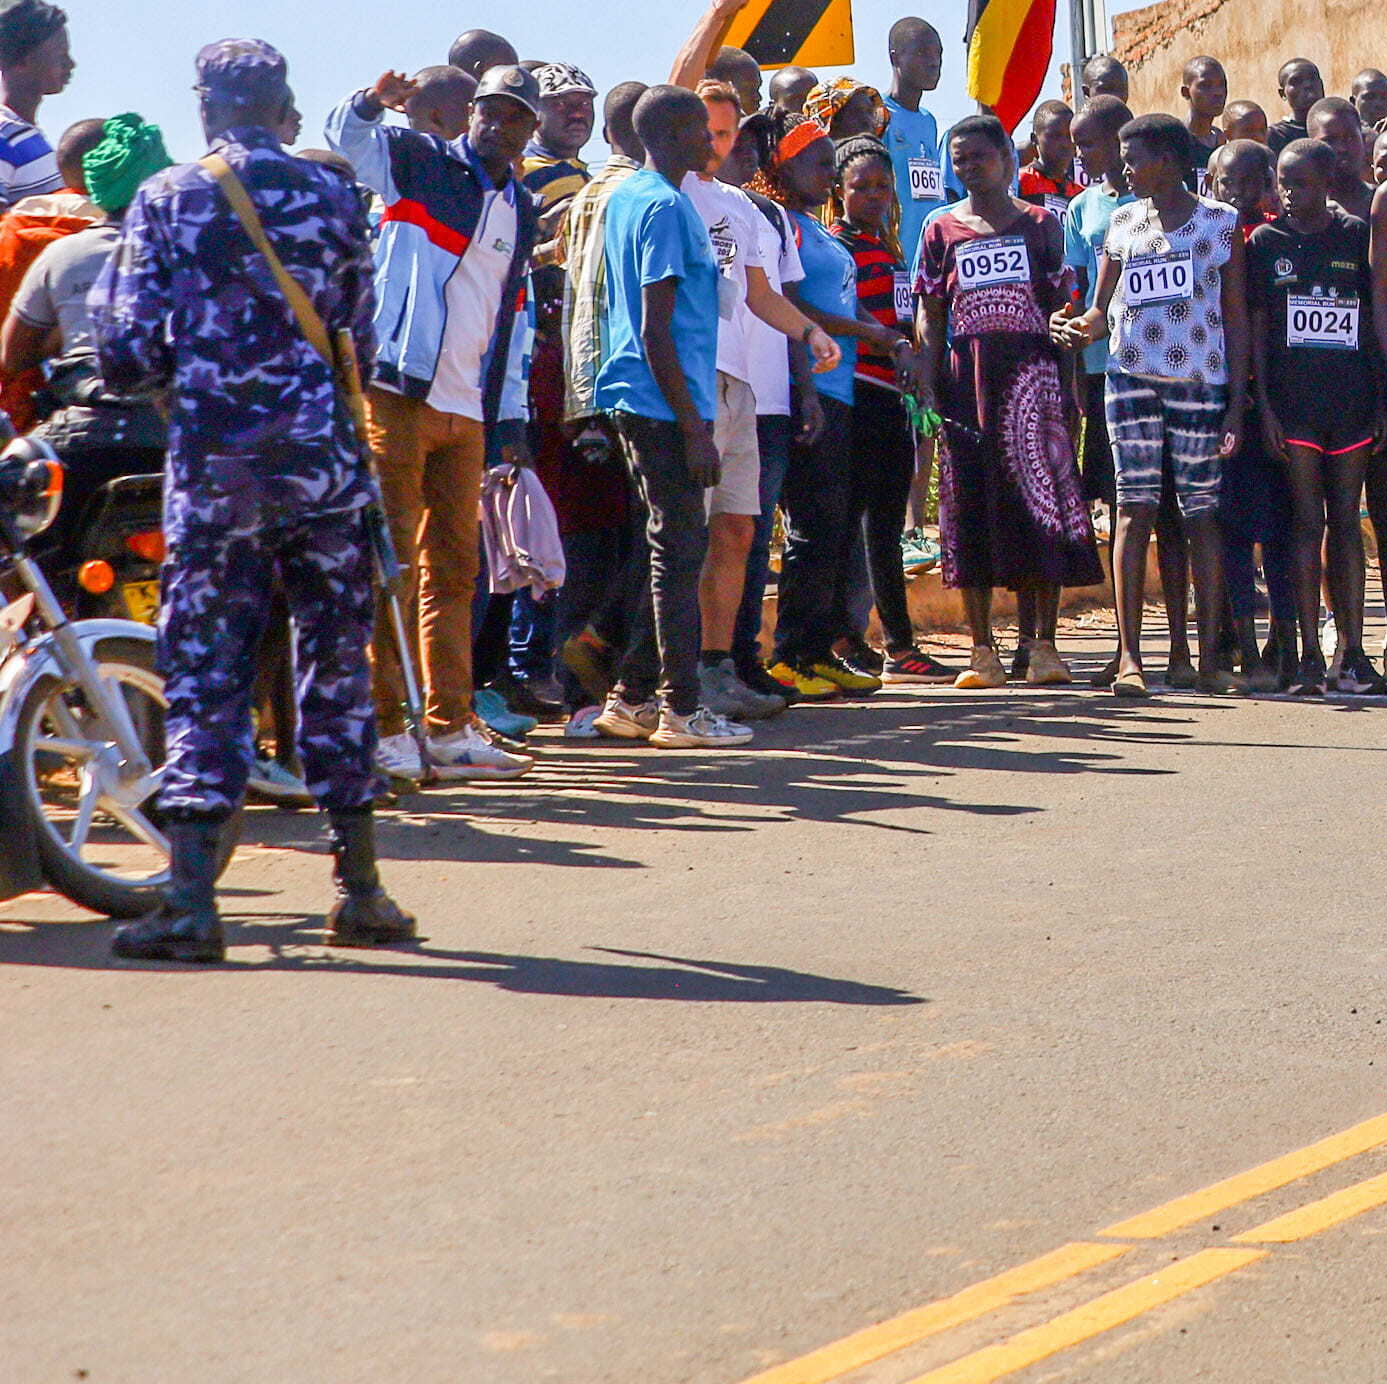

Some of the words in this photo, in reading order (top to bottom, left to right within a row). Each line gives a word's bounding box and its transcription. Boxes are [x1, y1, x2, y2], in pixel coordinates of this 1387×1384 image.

[961, 250, 1025, 279] 0952
[1129, 265, 1187, 294] 0110
[896, 287, 912, 308] 09
[1293, 309, 1353, 334] 0024
